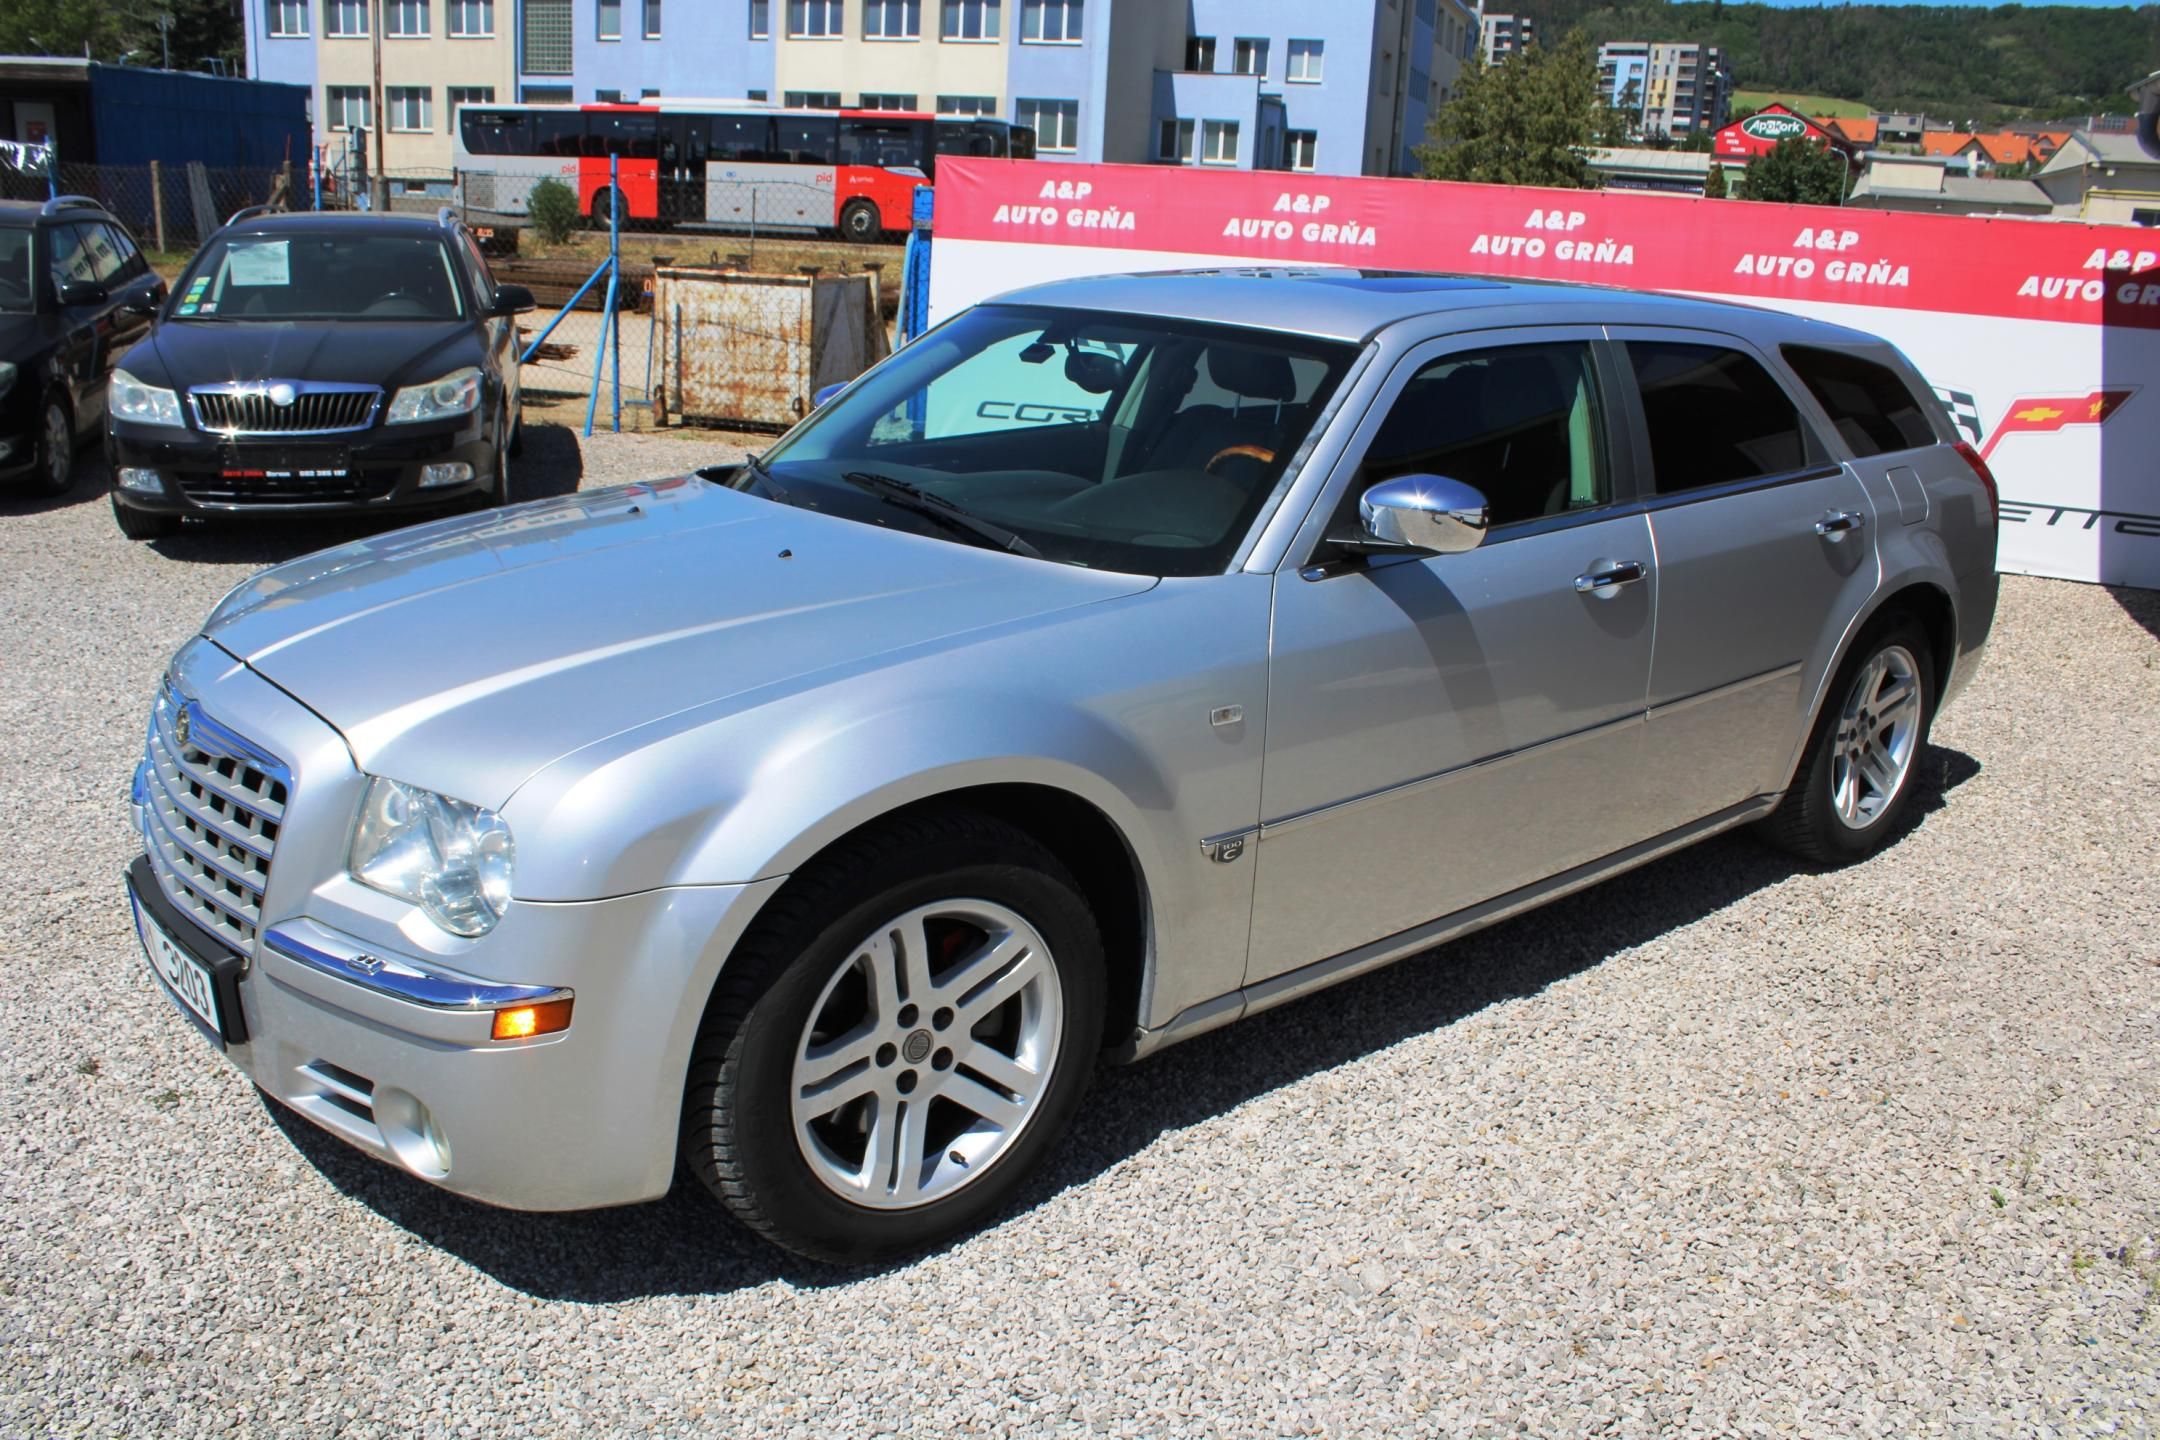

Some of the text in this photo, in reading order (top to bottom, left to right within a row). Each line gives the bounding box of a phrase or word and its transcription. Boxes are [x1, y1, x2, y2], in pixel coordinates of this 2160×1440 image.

[816, 172, 832, 185] pid
[1040, 181, 1092, 200] A&P
[1273, 193, 1330, 214] A&P
[993, 205, 1135, 230] AUTO GRŇA
[1524, 209, 1586, 230] A&P
[1223, 218, 1376, 246] AUTO GRŇA
[1793, 228, 1859, 250] A&P
[1470, 234, 1634, 264] AUTO GRŇA
[2082, 248, 2157, 273] A&P
[1734, 254, 1909, 286] AUTO GRŇA
[2016, 276, 2105, 302] AUTO
[976, 401, 1104, 423] COR
